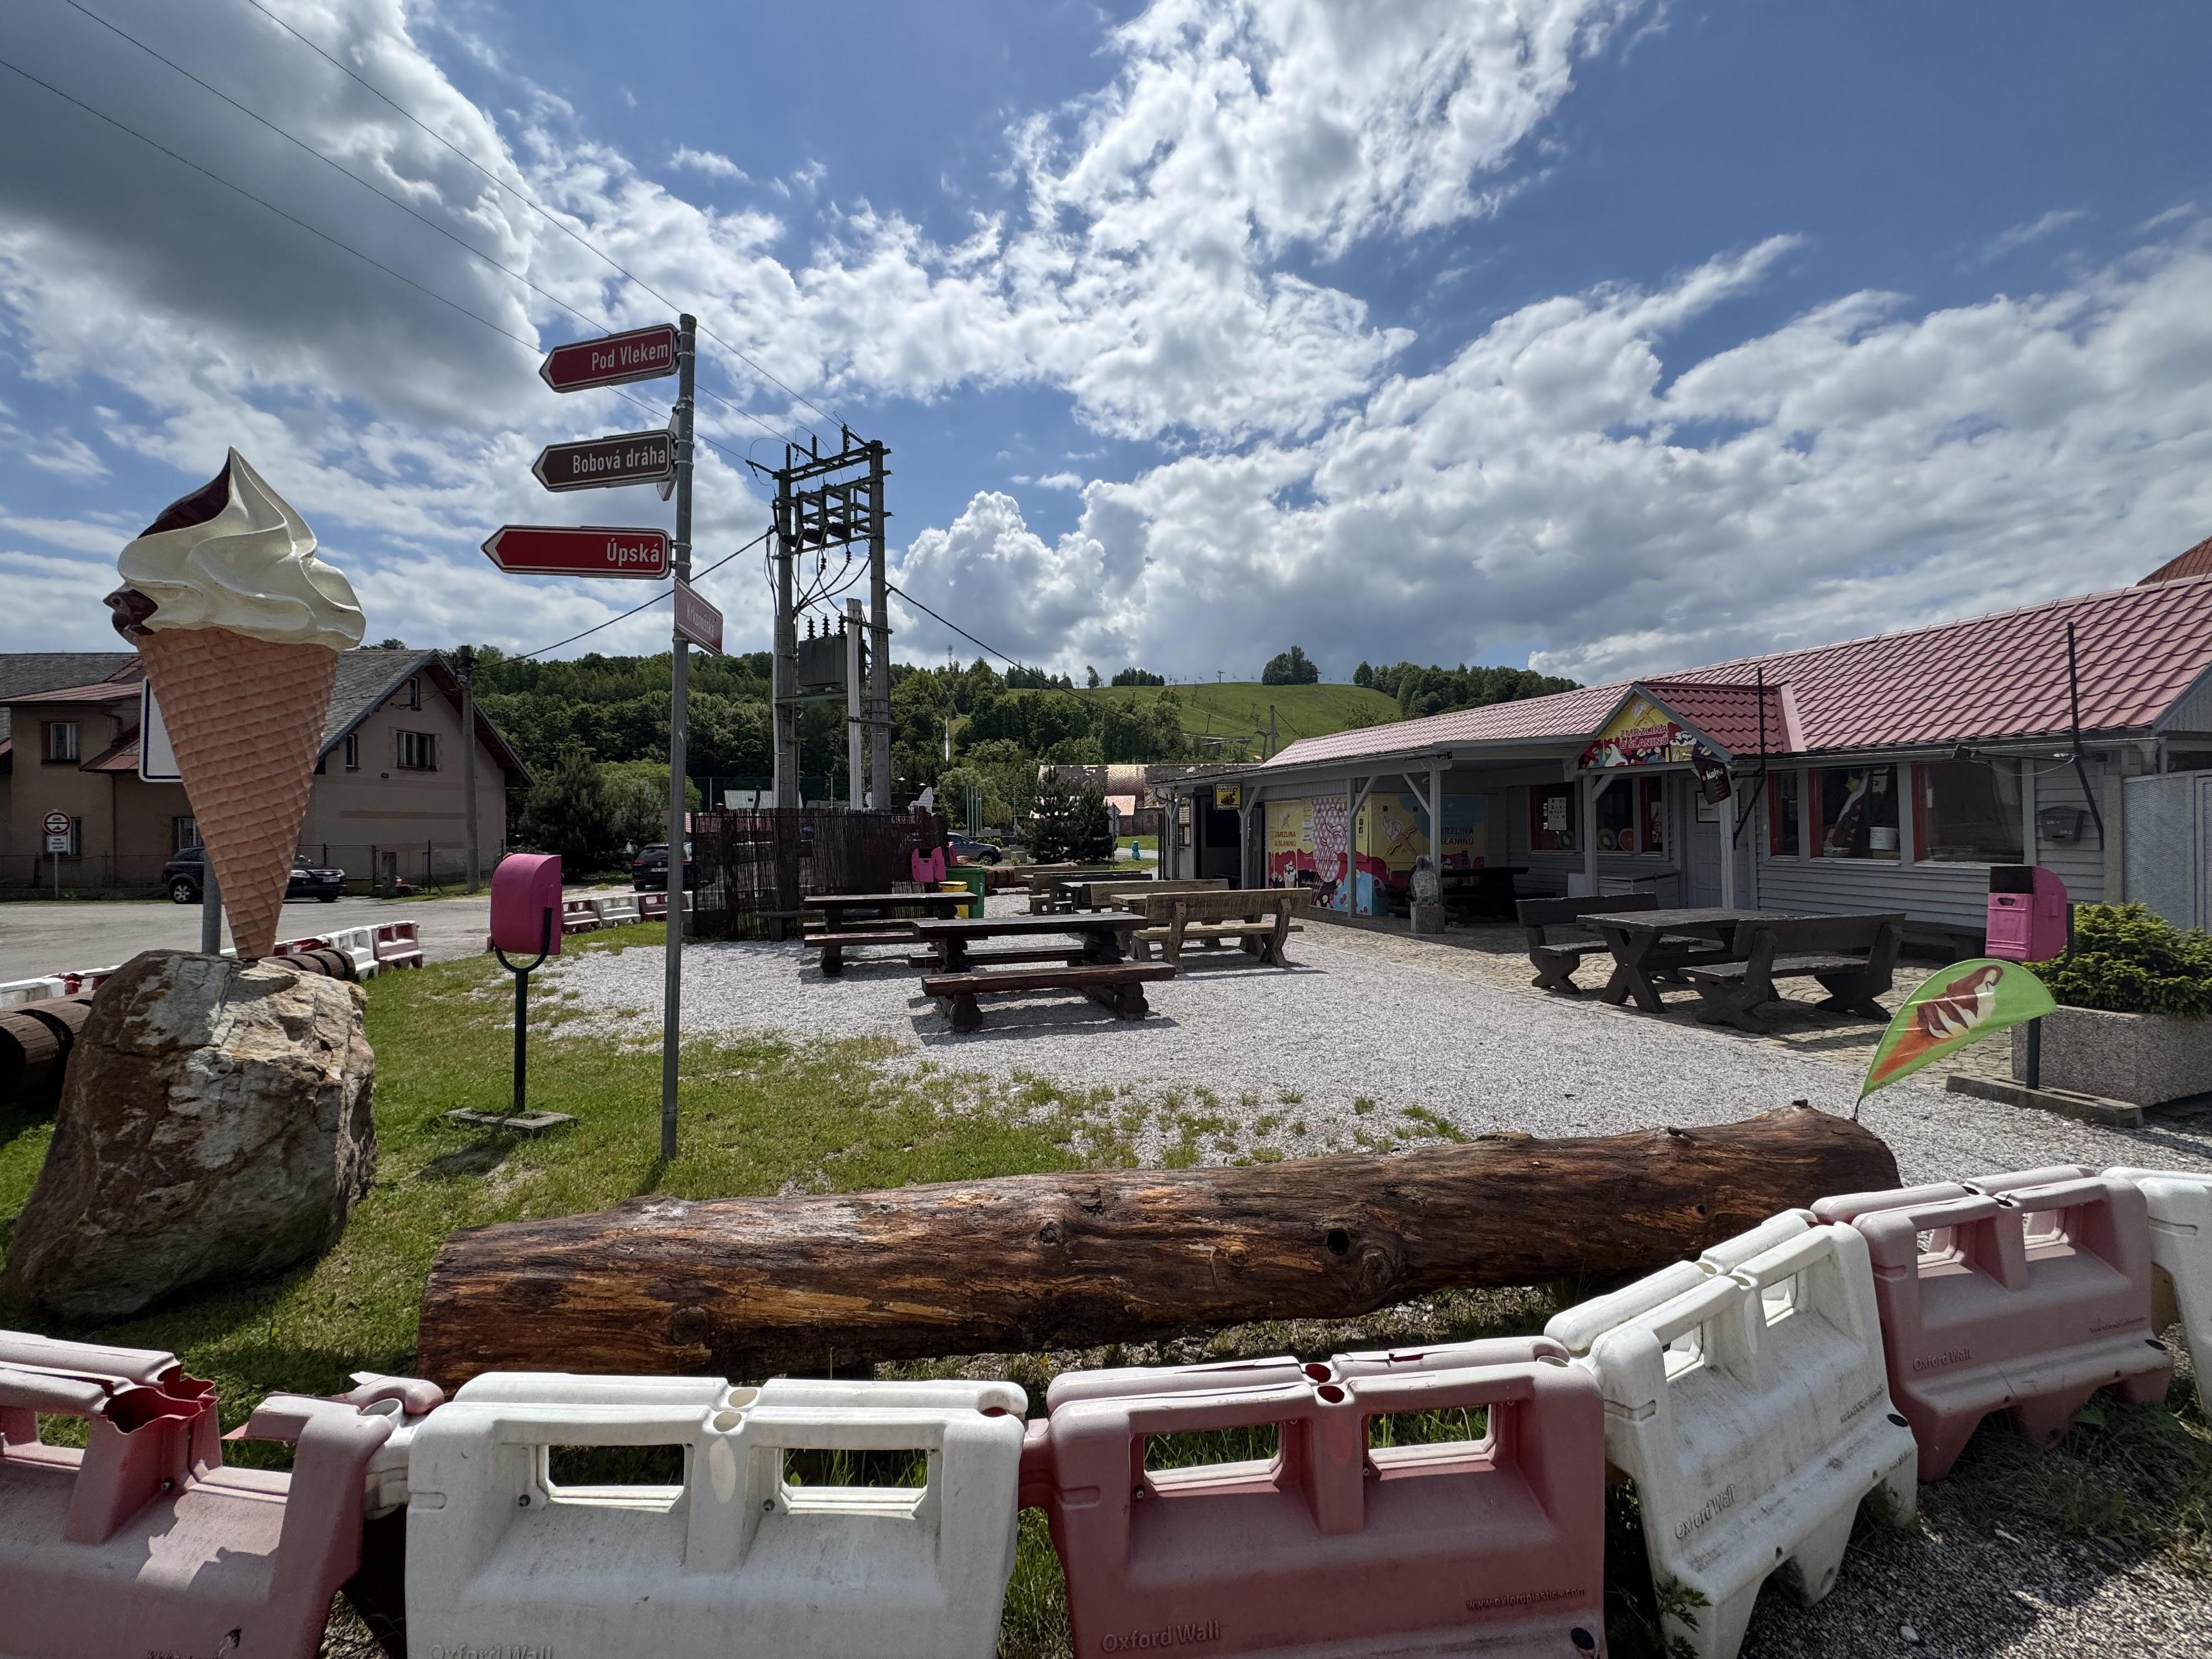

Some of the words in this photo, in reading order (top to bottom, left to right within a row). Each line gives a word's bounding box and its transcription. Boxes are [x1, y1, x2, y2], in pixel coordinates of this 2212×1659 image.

[592, 348, 615, 371] Pod
[620, 343, 669, 366] Vlekem
[573, 449, 620, 474] Bobová
[626, 446, 666, 468] dráha
[607, 538, 660, 567] Úpská
[687, 601, 714, 638] Krkonošská
[1619, 737, 1626, 749] U
[1620, 724, 1668, 738] ZMRZLINA
[1912, 1352, 1948, 1371] Oxford
[1949, 1347, 1971, 1363] Wall
[1674, 1499, 1712, 1540] Oxford
[1712, 1484, 1735, 1514] Wall
[1101, 1625, 1173, 1653] Oxford
[1176, 1619, 1222, 1645] Wall
